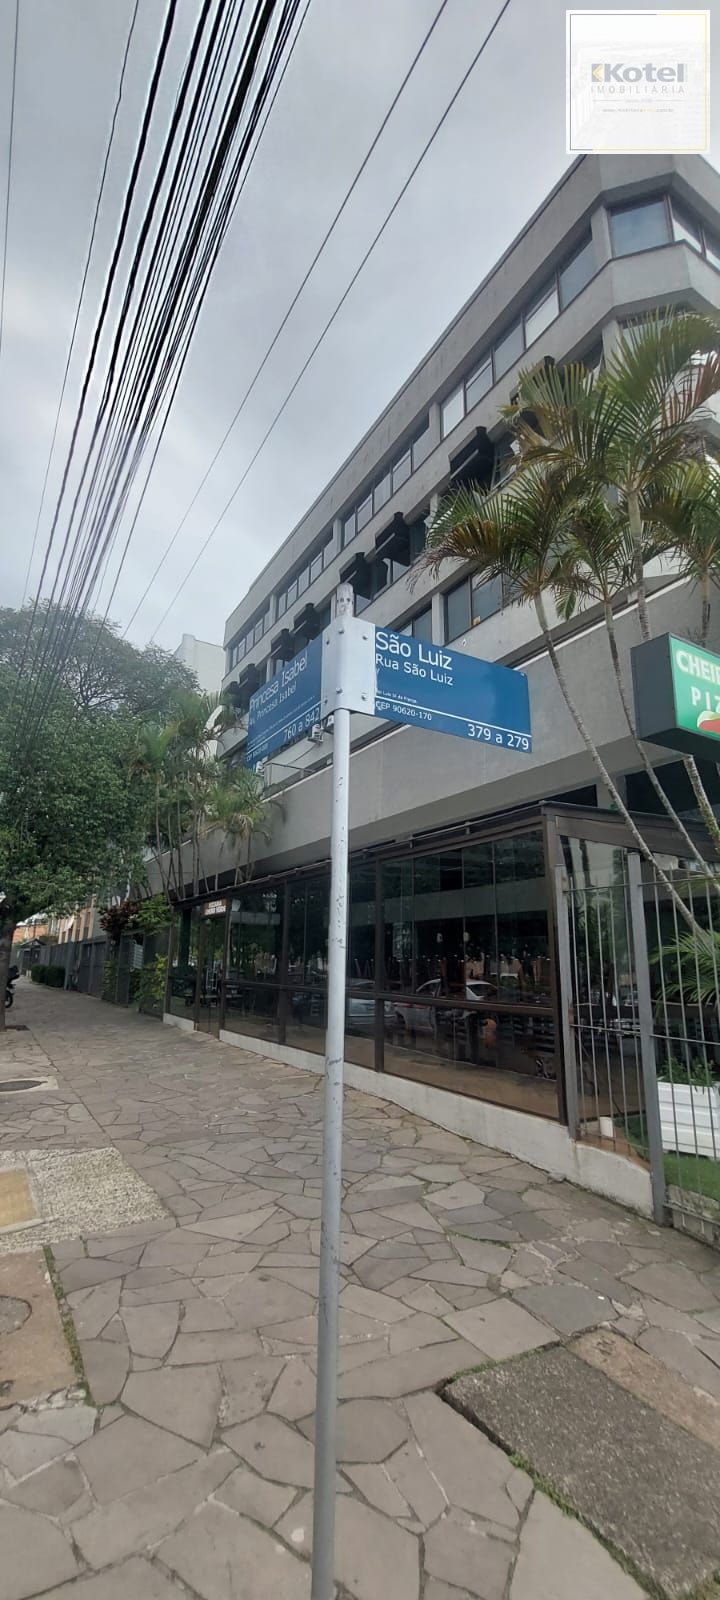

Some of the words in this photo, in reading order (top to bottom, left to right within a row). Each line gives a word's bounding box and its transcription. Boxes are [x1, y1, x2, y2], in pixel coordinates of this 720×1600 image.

[375, 631, 411, 658] São
[418, 643, 453, 671] Luiz
[249, 680, 279, 711] Princesa
[281, 649, 308, 687] Isabel
[375, 653, 399, 671] Rua
[403, 661, 426, 678] São
[430, 669, 454, 686] Luiz
[283, 723, 296, 741] 760
[298, 721, 303, 732] a
[305, 707, 320, 728] 842
[375, 700, 390, 710] CEP
[392, 703, 432, 721] 90620-170
[467, 723, 491, 741] 379
[495, 733, 503, 744] a
[507, 733, 529, 750] 279
